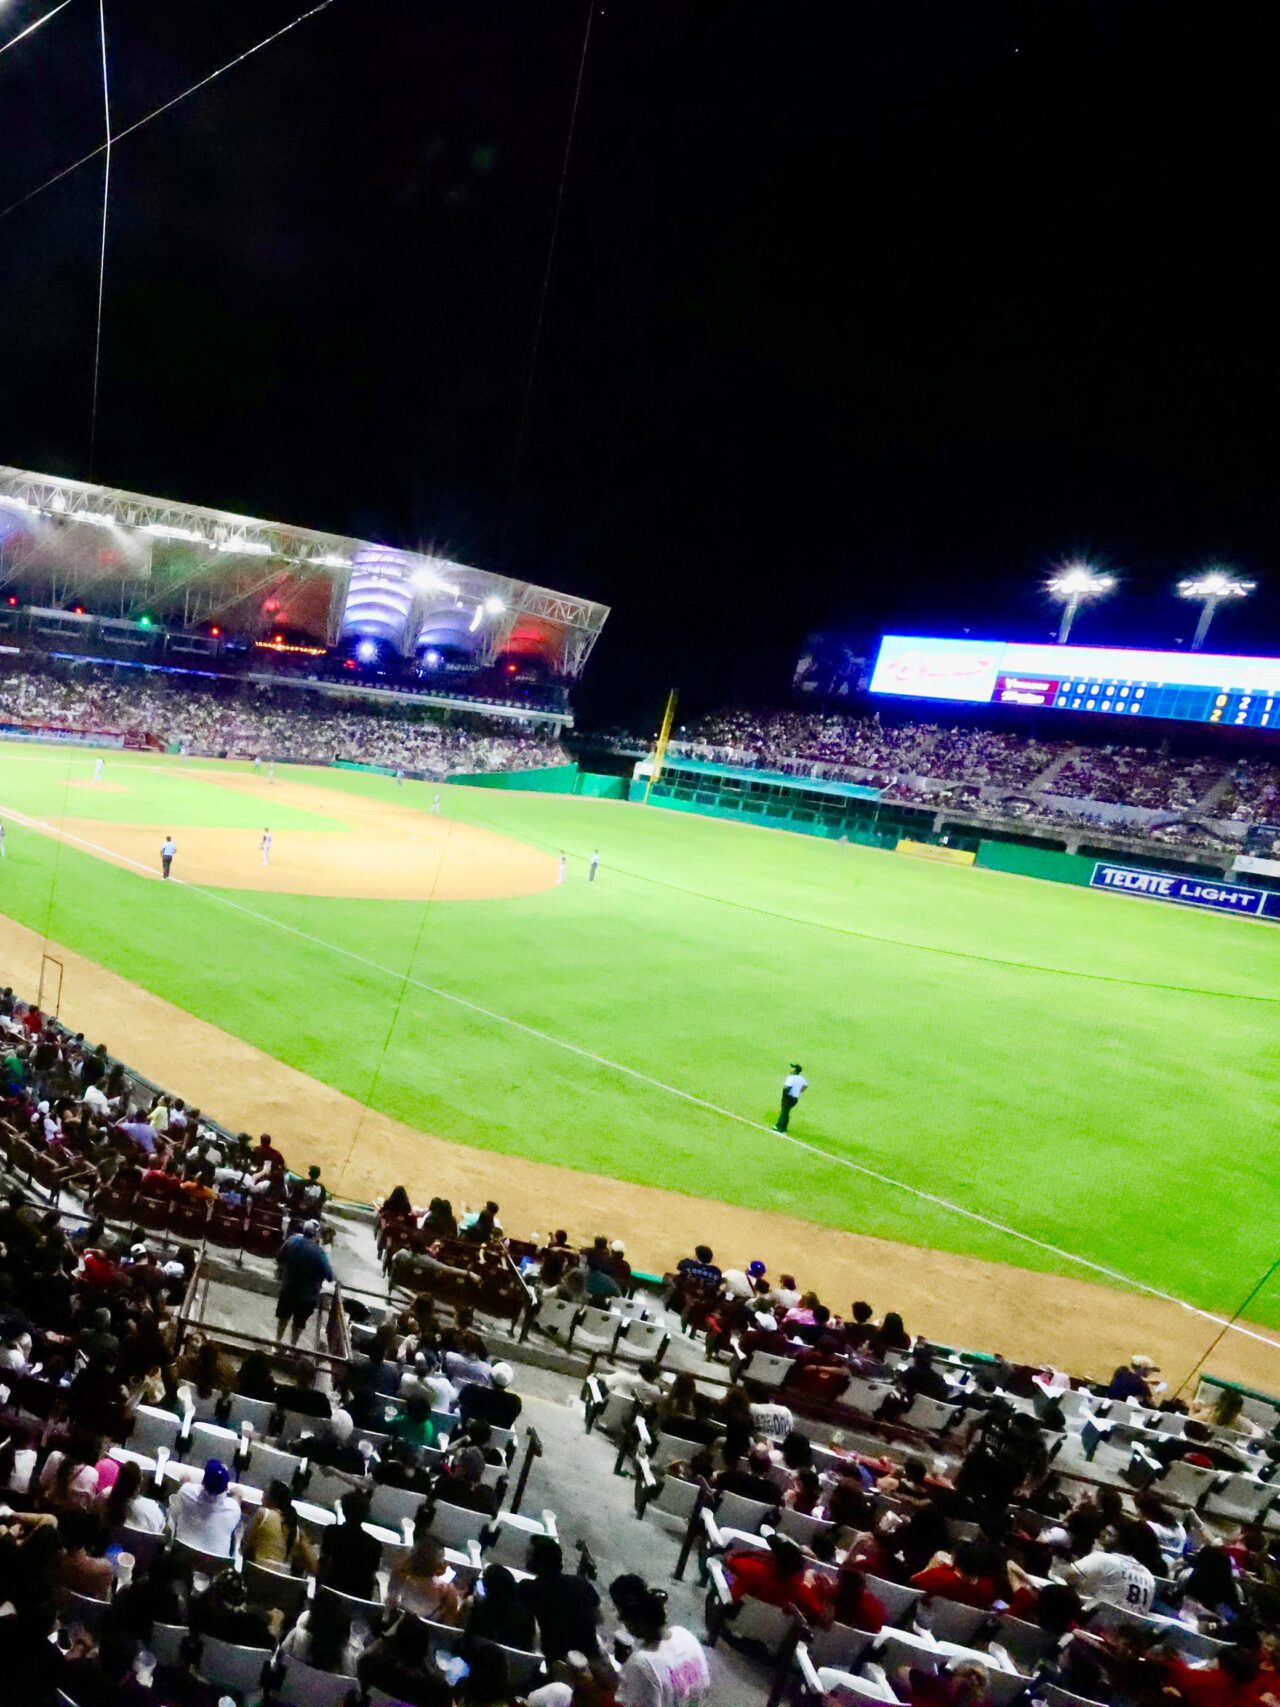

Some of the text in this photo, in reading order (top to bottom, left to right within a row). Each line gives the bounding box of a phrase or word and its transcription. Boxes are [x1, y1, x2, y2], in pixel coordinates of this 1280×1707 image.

[1072, 698, 1081, 709] 2
[1209, 709, 1222, 722] 2
[1234, 711, 1247, 724] 2
[1261, 713, 1270, 726] 1
[1215, 694, 1227, 707] 0
[1238, 696, 1251, 709] 2
[1264, 698, 1273, 711] 1
[1101, 868, 1255, 906] TECATE LIGHT
[1126, 1583, 1148, 1606] 81
